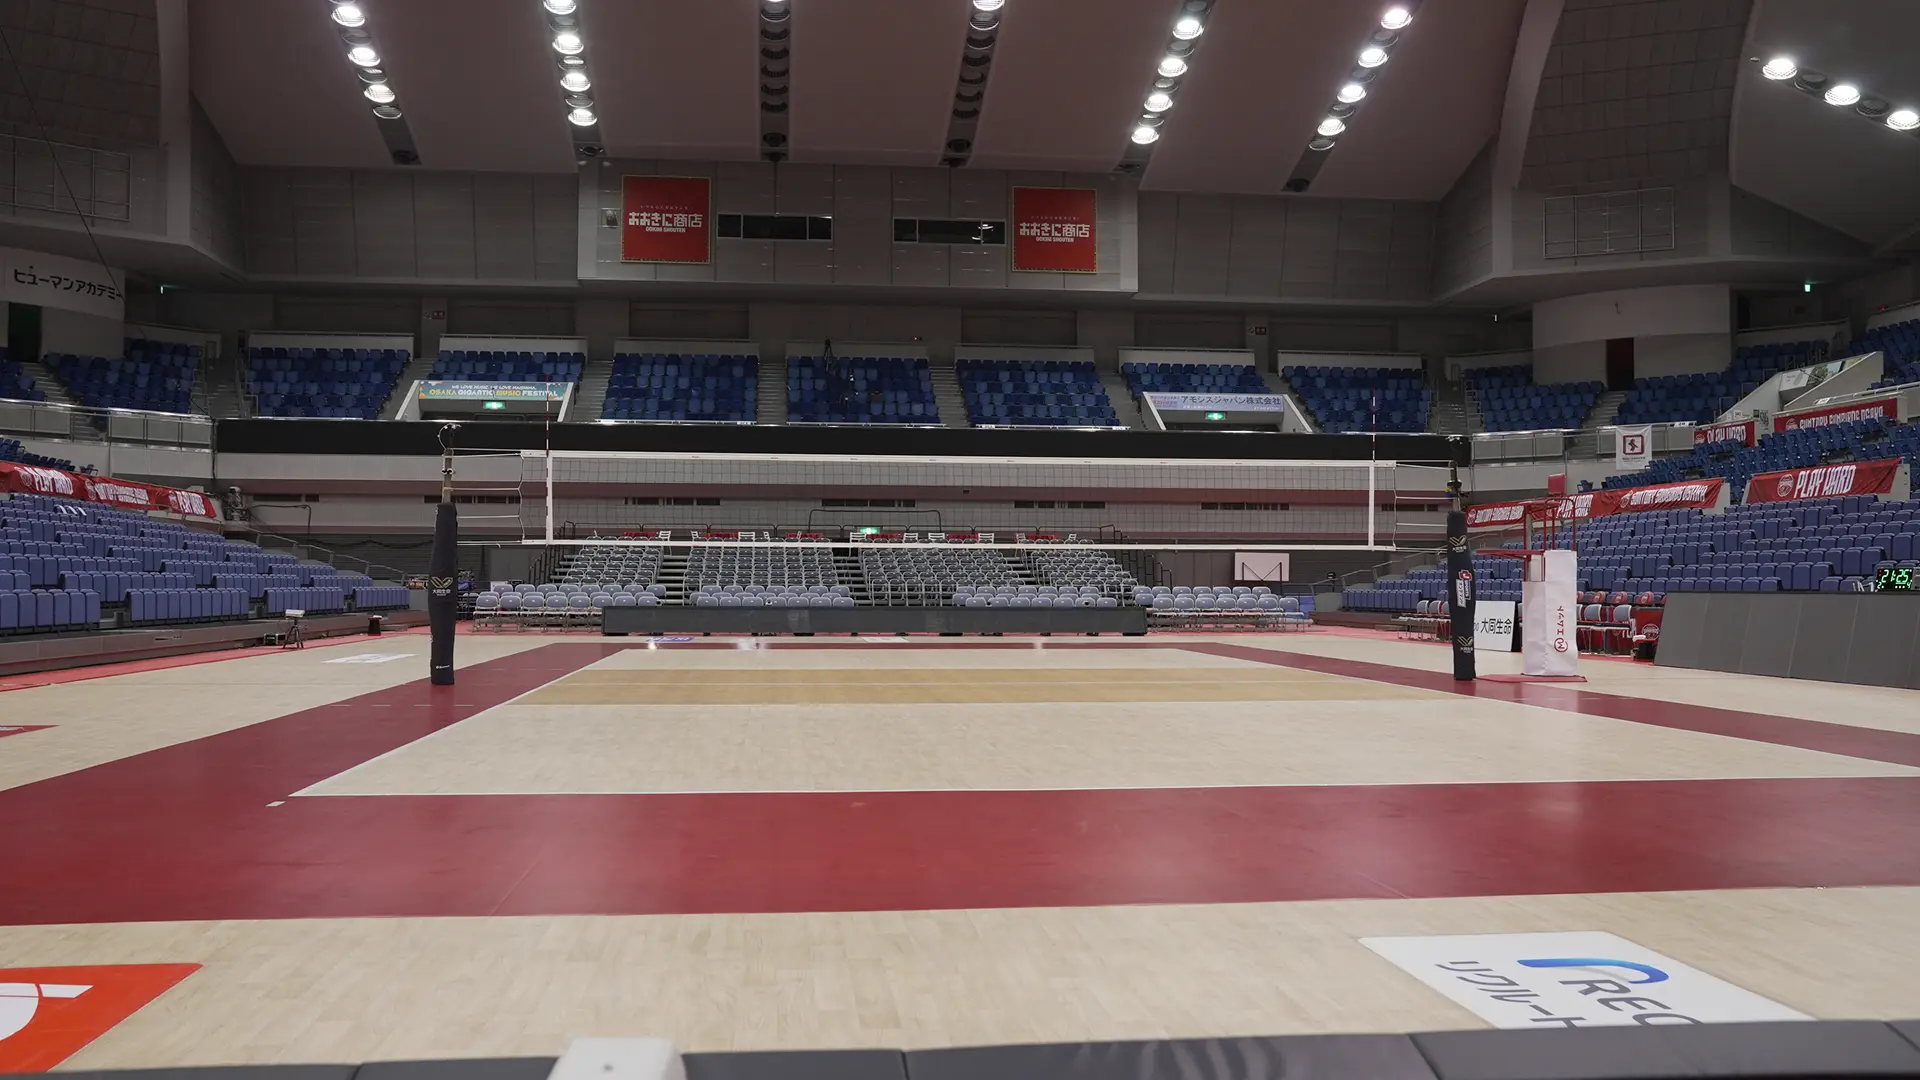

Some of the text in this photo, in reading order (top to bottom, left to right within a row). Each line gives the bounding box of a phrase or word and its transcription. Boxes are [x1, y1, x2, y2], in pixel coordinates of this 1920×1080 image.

[628, 211, 703, 228] おおきに商店
[1019, 222, 1091, 238] おおきに商店
[14, 268, 122, 300] ヒューマンアカデミー
[1793, 464, 1857, 498] PLAY HARD
[1480, 618, 1512, 635] 大同生命
[1557, 605, 1565, 635] エムット
